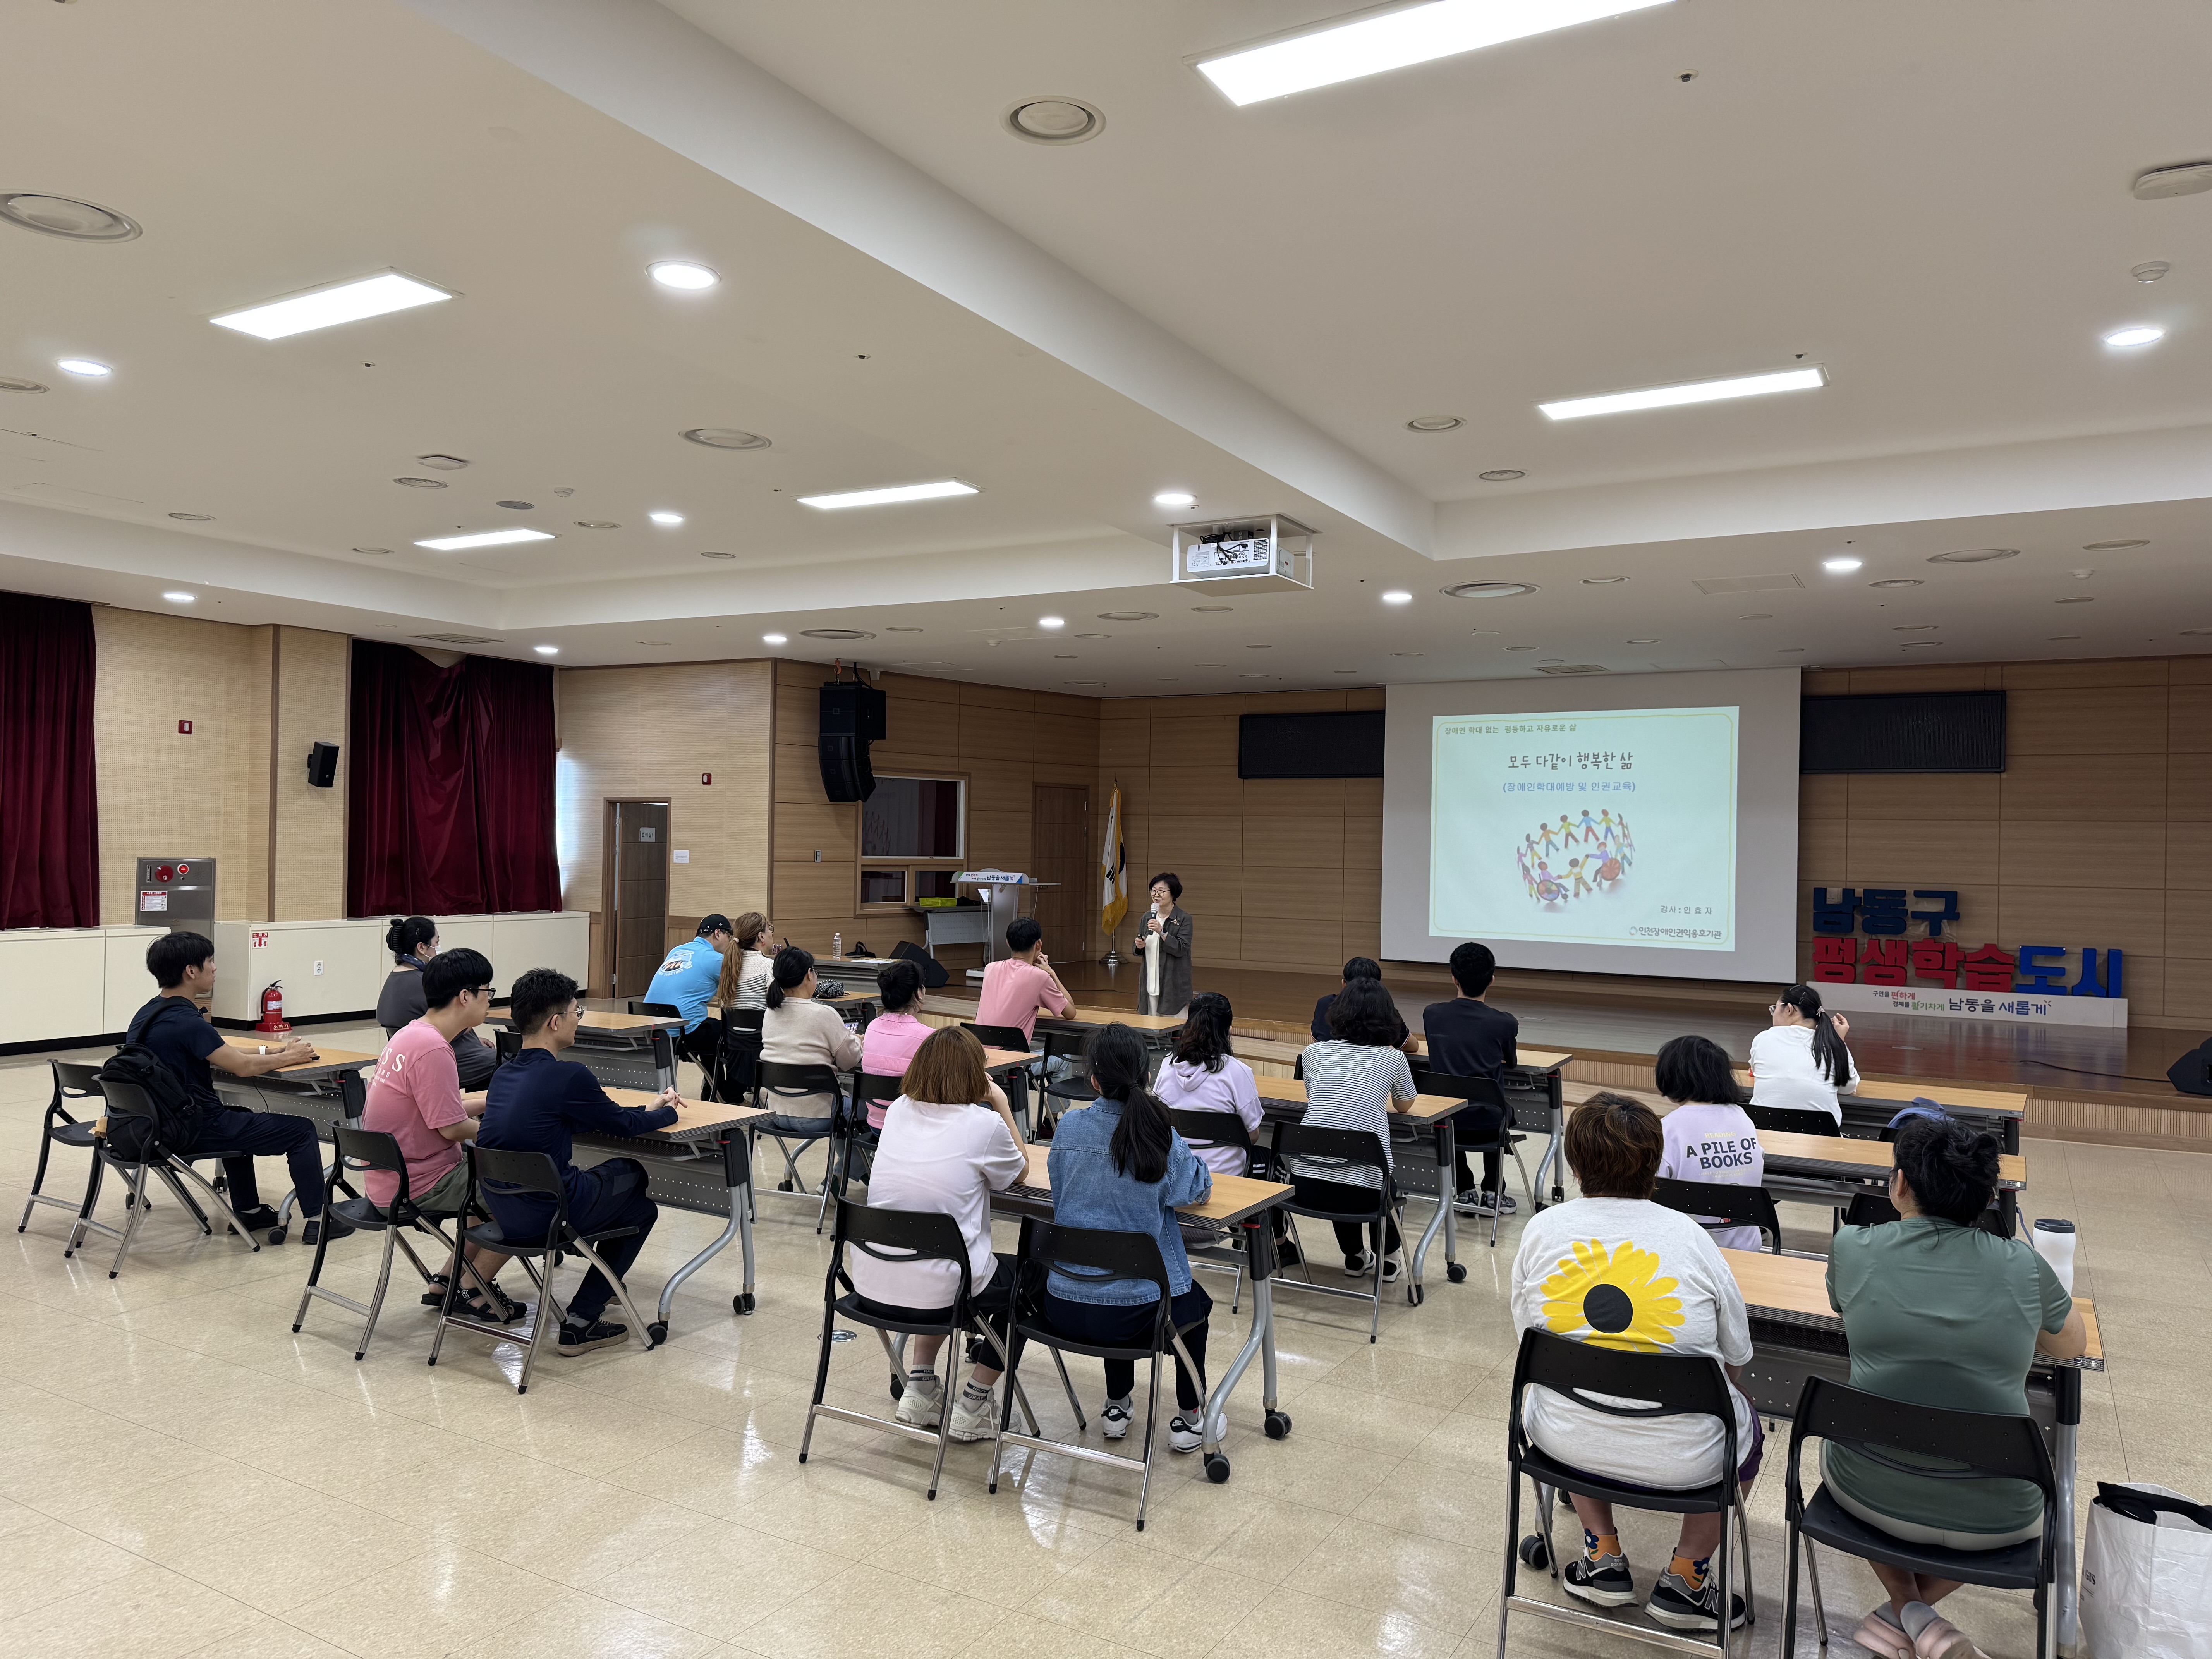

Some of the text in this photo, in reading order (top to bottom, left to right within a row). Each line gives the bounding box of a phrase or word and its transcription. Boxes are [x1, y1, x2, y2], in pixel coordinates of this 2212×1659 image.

[1536, 724, 1566, 732] 자유로운
[1569, 723, 1577, 732] 삶
[1508, 751, 1633, 770] 모두 다같이 행복한 삶
[1503, 781, 1636, 792] (장애인학대예방 및 인권교육)
[1812, 886, 1960, 937] 남동구
[1891, 990, 1915, 1000] 편하게
[1911, 1001, 1944, 1011] 활기차게
[1949, 998, 2047, 1016] 남동을 새롭게
[1686, 1137, 1756, 1158] A PILE OF
[1700, 1152, 1753, 1169] BOOKS
